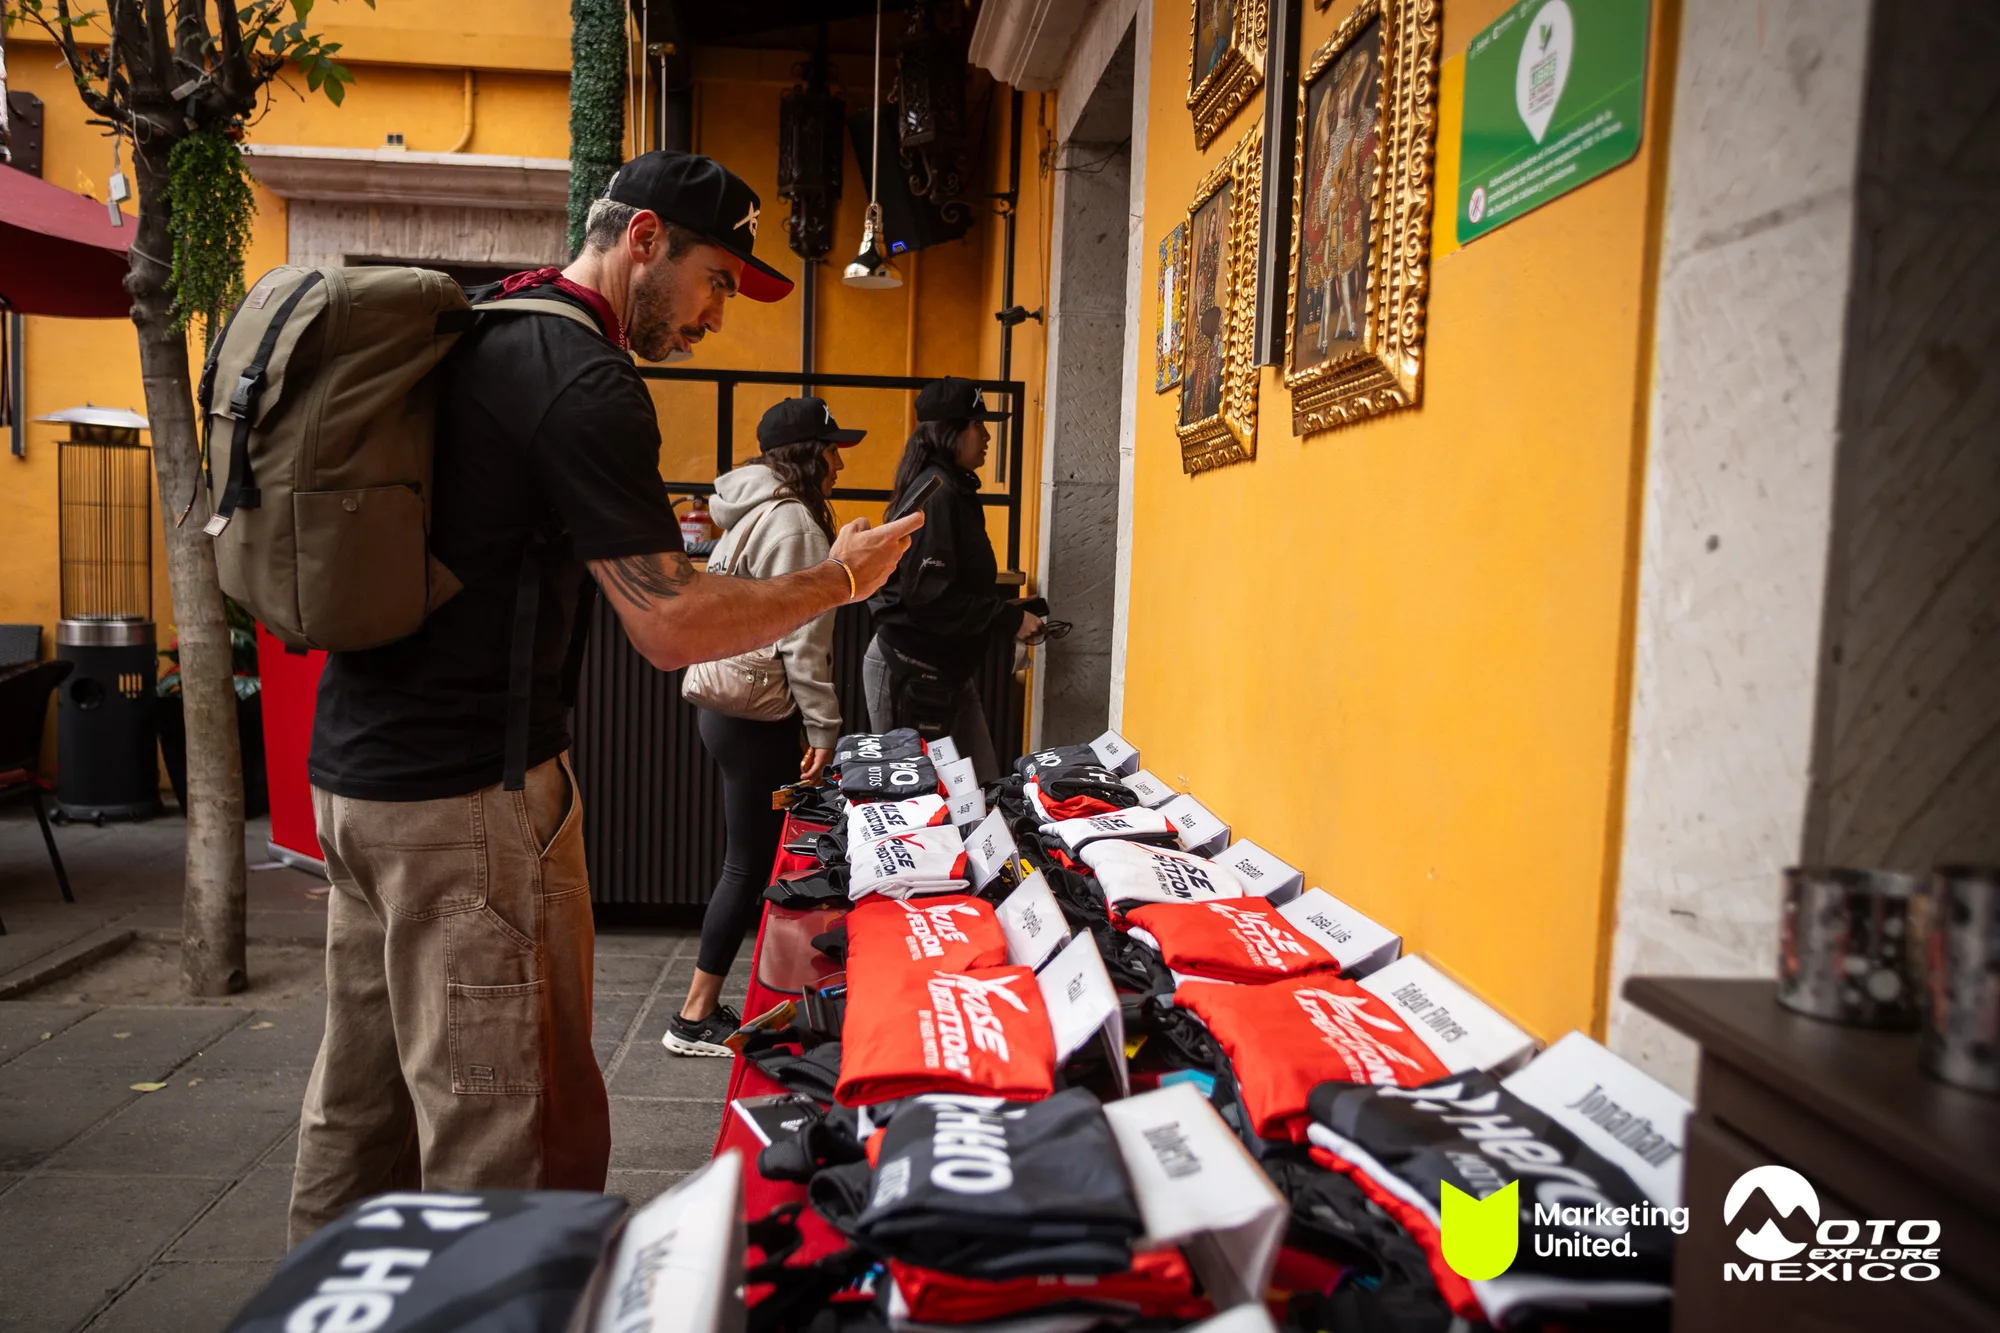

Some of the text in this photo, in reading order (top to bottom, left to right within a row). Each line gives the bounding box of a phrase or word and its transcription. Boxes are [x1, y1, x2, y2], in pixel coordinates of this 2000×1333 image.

[1235, 858, 1264, 880] Esteban
[1325, 923, 1352, 944] Luis
[1391, 982, 1468, 1044] Edgar Flores
[1565, 1083, 1681, 1168] Jonathan
